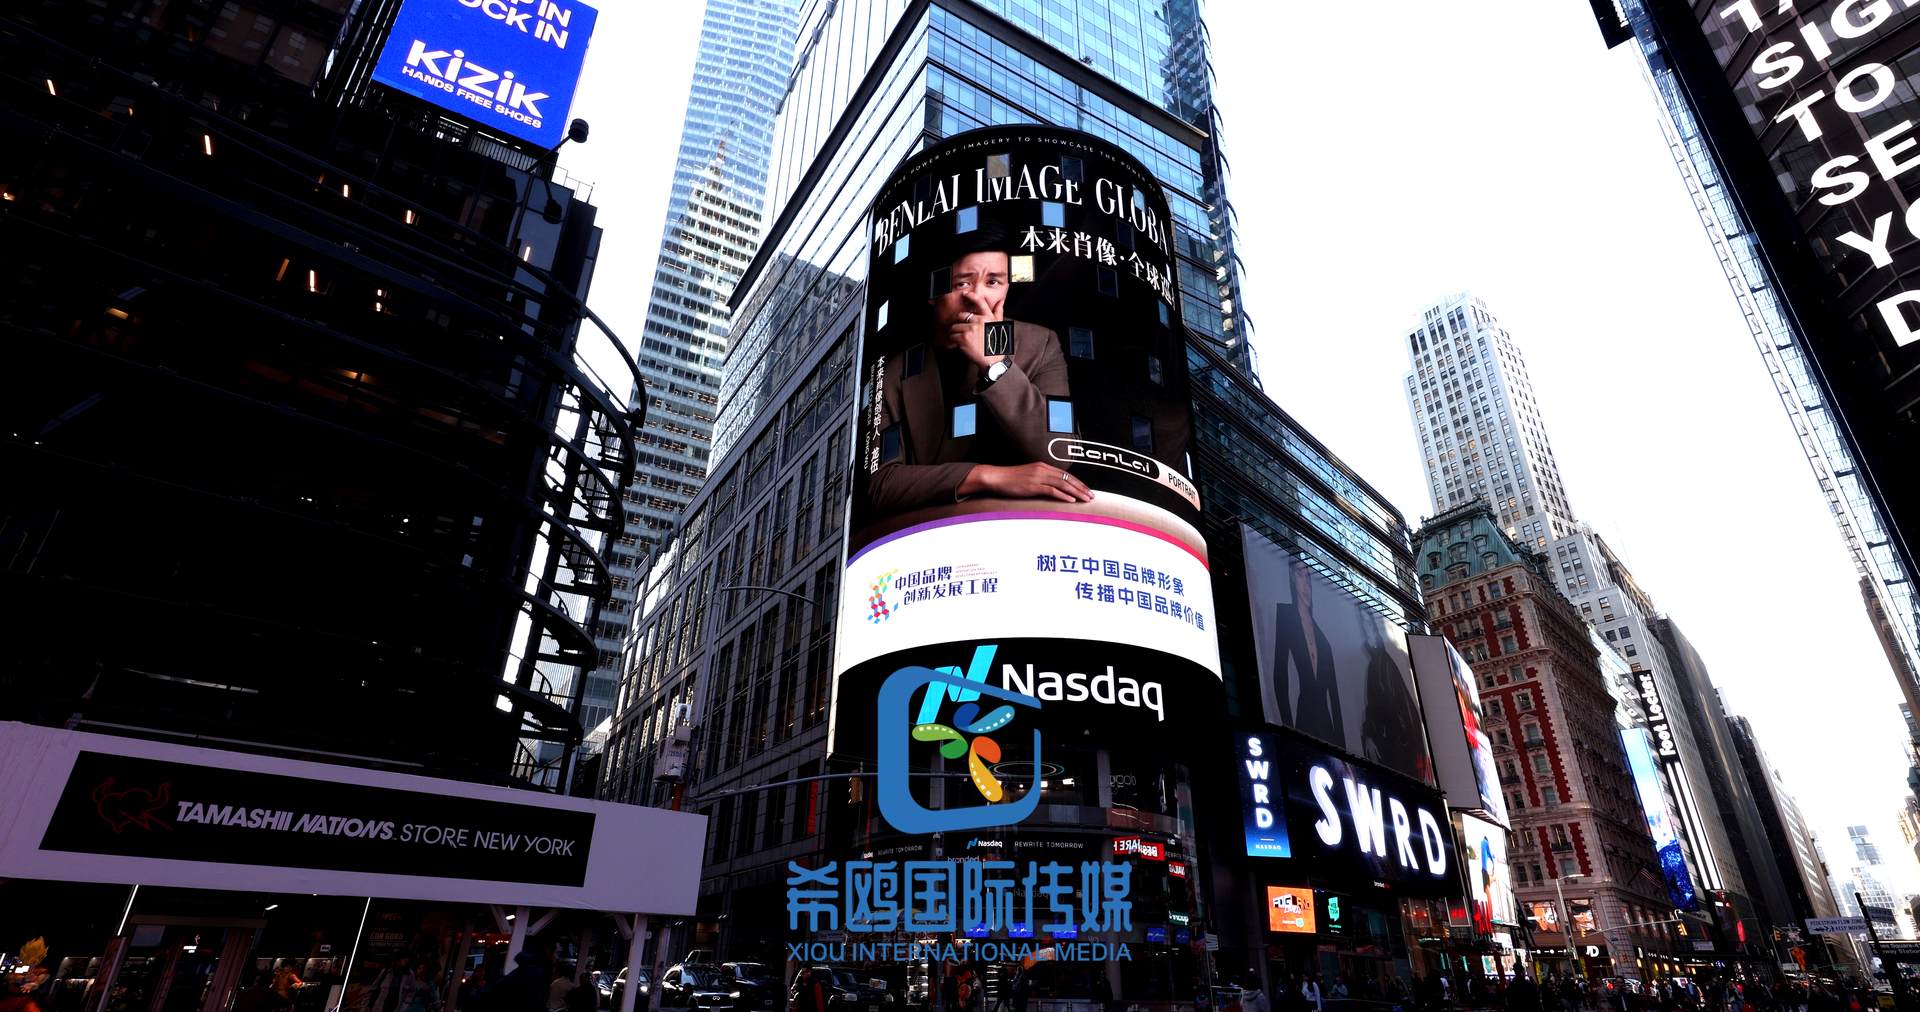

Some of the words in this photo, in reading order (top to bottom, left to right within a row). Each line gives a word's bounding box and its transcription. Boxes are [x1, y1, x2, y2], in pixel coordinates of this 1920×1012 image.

[534, 19, 569, 50] IN
[402, 65, 455, 94] HANDS
[456, 88, 493, 110] FREE
[495, 103, 542, 129] SHOES
[1775, 62, 1896, 143] TO
[963, 137, 1011, 151] IMAGERY
[1037, 136, 1094, 153] SHOWCASE
[975, 164, 1083, 206] IMAGE
[895, 566, 952, 591] 中国品牌
[903, 577, 998, 606] 创新发展工程
[1036, 554, 1185, 597] 树立中国品牌形象
[1075, 581, 1205, 631] 传播中国品牌价值
[1002, 662, 1165, 722] Nasdaq
[1245, 737, 1275, 828] SWRD
[176, 801, 294, 830] TAMASHII
[293, 813, 395, 841] NATIONS
[400, 823, 469, 849] STORE
[473, 831, 521, 852] NEW
[523, 835, 576, 857] YORK
[1309, 765, 1447, 876] SWRD
[977, 839, 1003, 850] Nasdaq
[1014, 840, 1044, 848] REWRITE
[1046, 841, 1085, 849] TOMORROW
